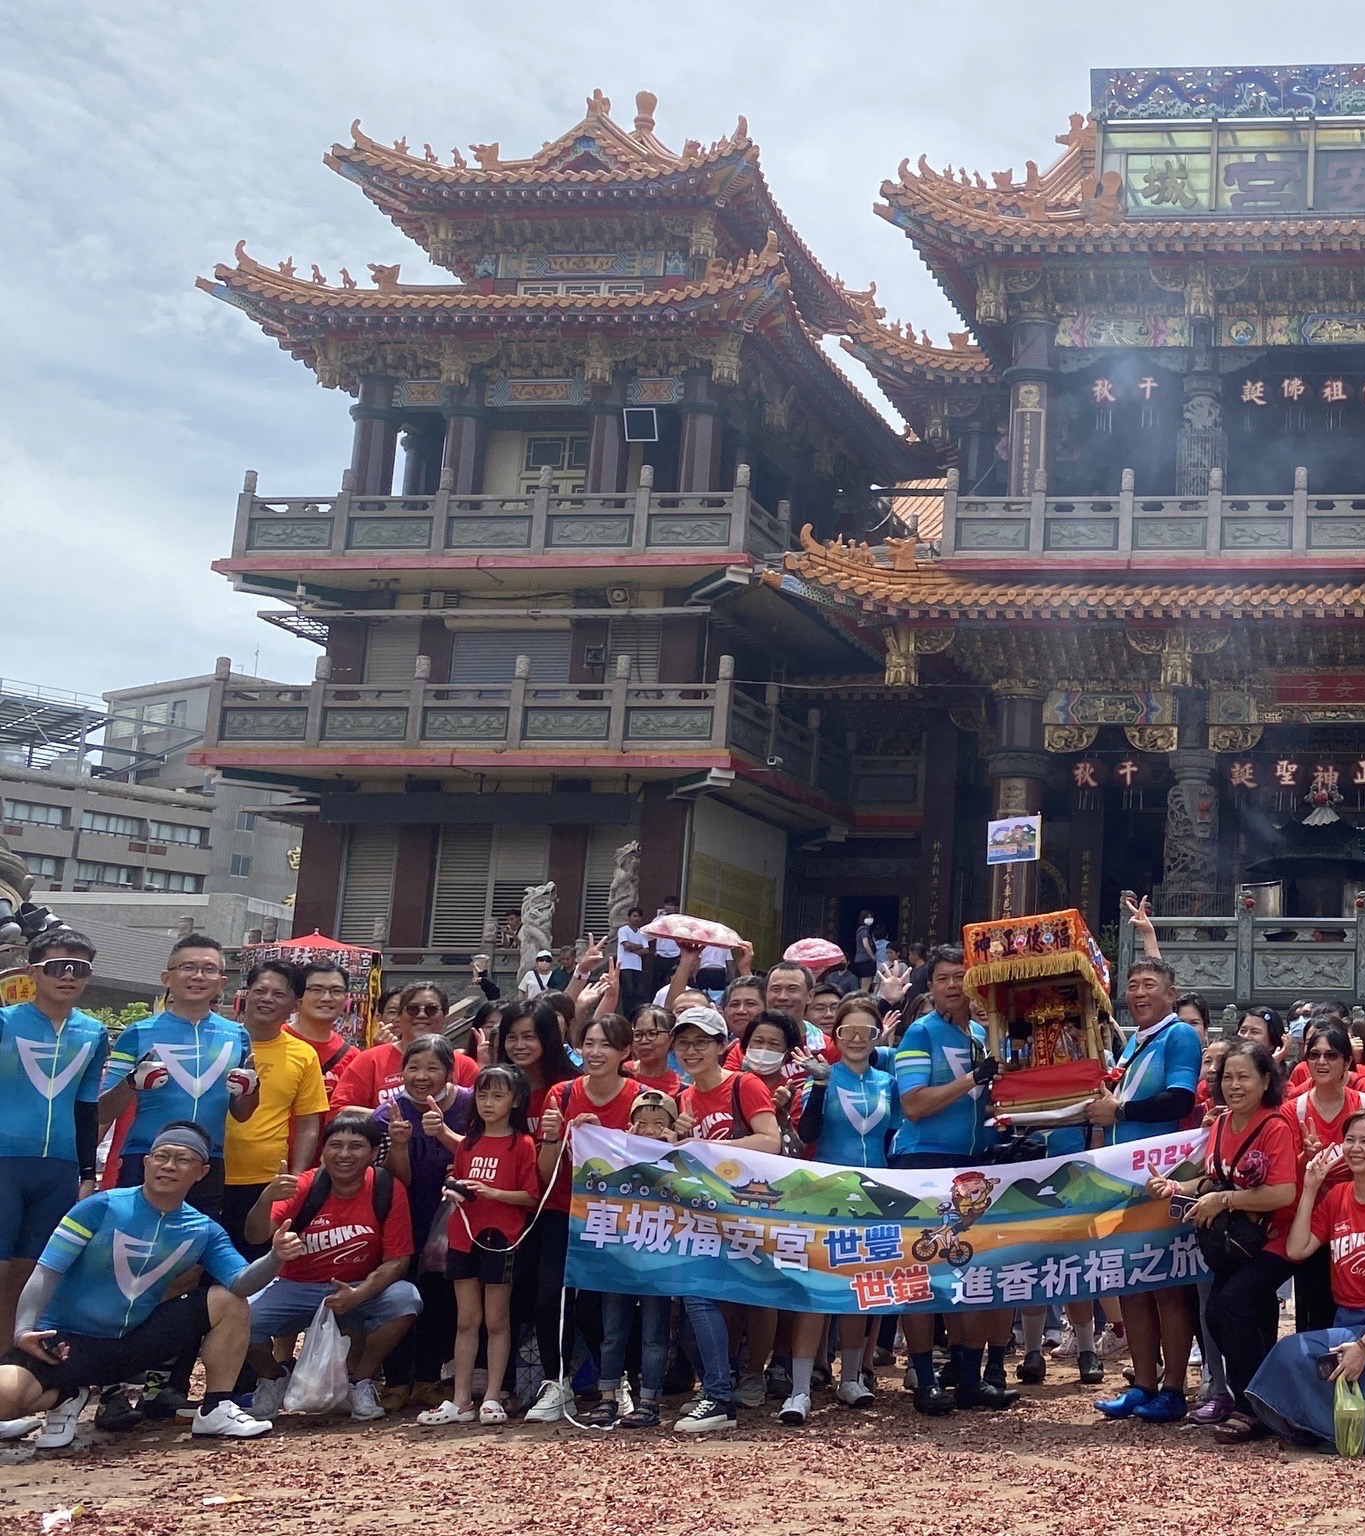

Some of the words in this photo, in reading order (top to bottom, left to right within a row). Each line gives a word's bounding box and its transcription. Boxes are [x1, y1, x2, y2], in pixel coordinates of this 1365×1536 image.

[1132, 1142, 1195, 1171] 2024
[579, 1199, 815, 1272] 車城福安宮
[822, 1222, 903, 1268] 世豐
[850, 1264, 935, 1312] 世鎧
[950, 1233, 1210, 1306] 進香祈福之旅
